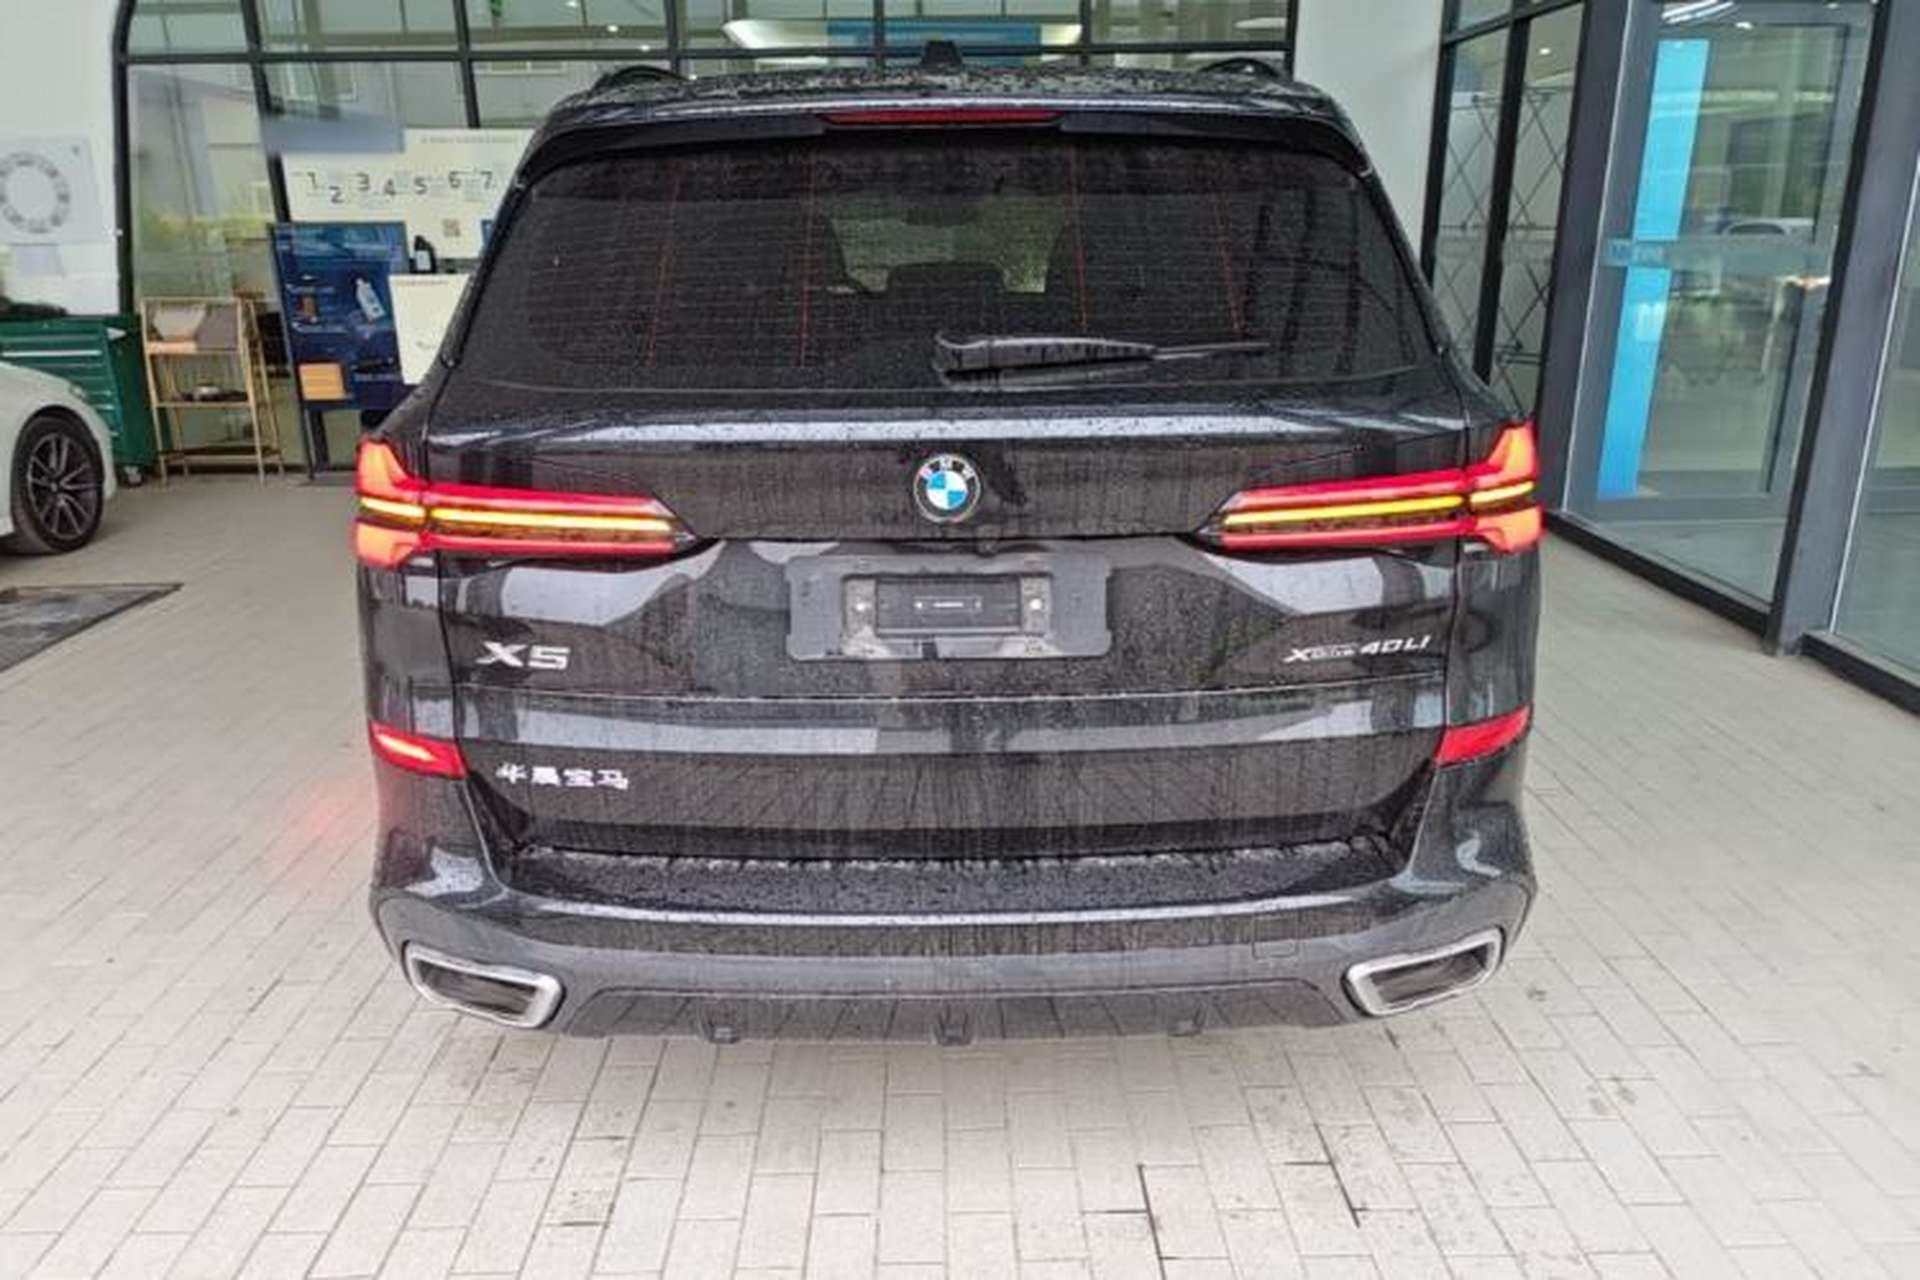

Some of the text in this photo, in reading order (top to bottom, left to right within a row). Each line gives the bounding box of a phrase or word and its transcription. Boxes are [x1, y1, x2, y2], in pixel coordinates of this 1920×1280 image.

[307, 171, 494, 204] 1 2 3 4 5 6 7
[475, 640, 571, 671] X5
